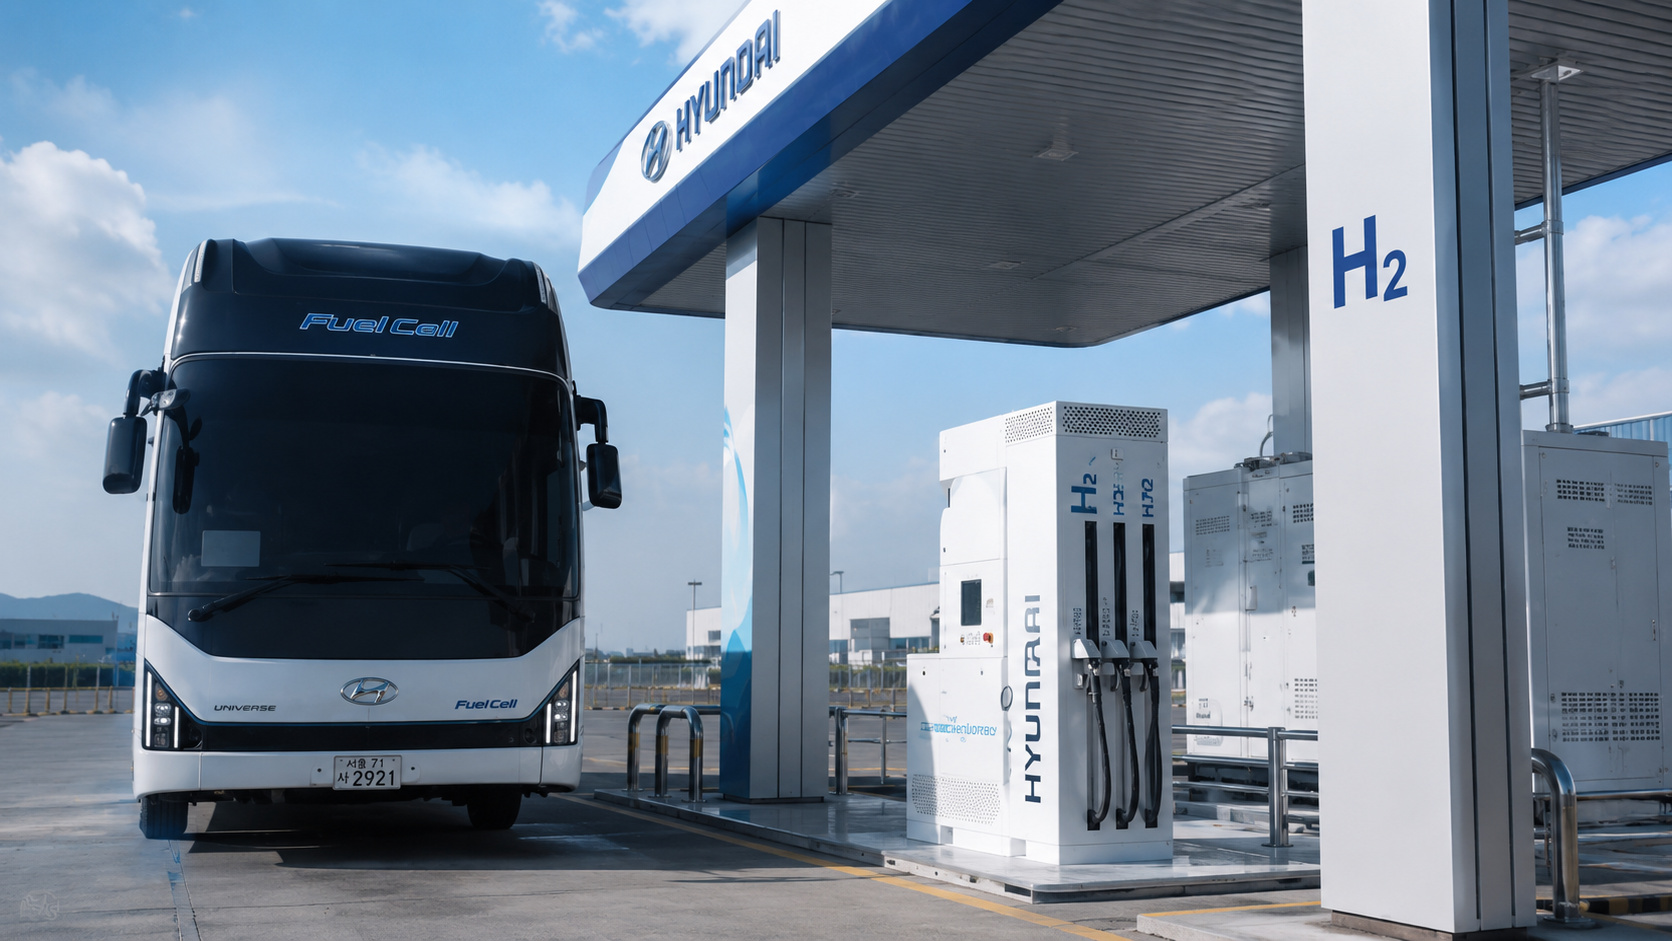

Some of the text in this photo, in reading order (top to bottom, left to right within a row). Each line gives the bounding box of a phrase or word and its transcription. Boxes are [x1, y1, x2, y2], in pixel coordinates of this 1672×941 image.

[676, 9, 780, 153] HYUNDAI
[1332, 214, 1408, 309] H2
[299, 312, 459, 338] Fuel Cell
[213, 704, 277, 712] UNIVERSE
[454, 698, 518, 710] Fuel Cell
[371, 758, 384, 768] 71
[337, 769, 395, 787] 사 2921
